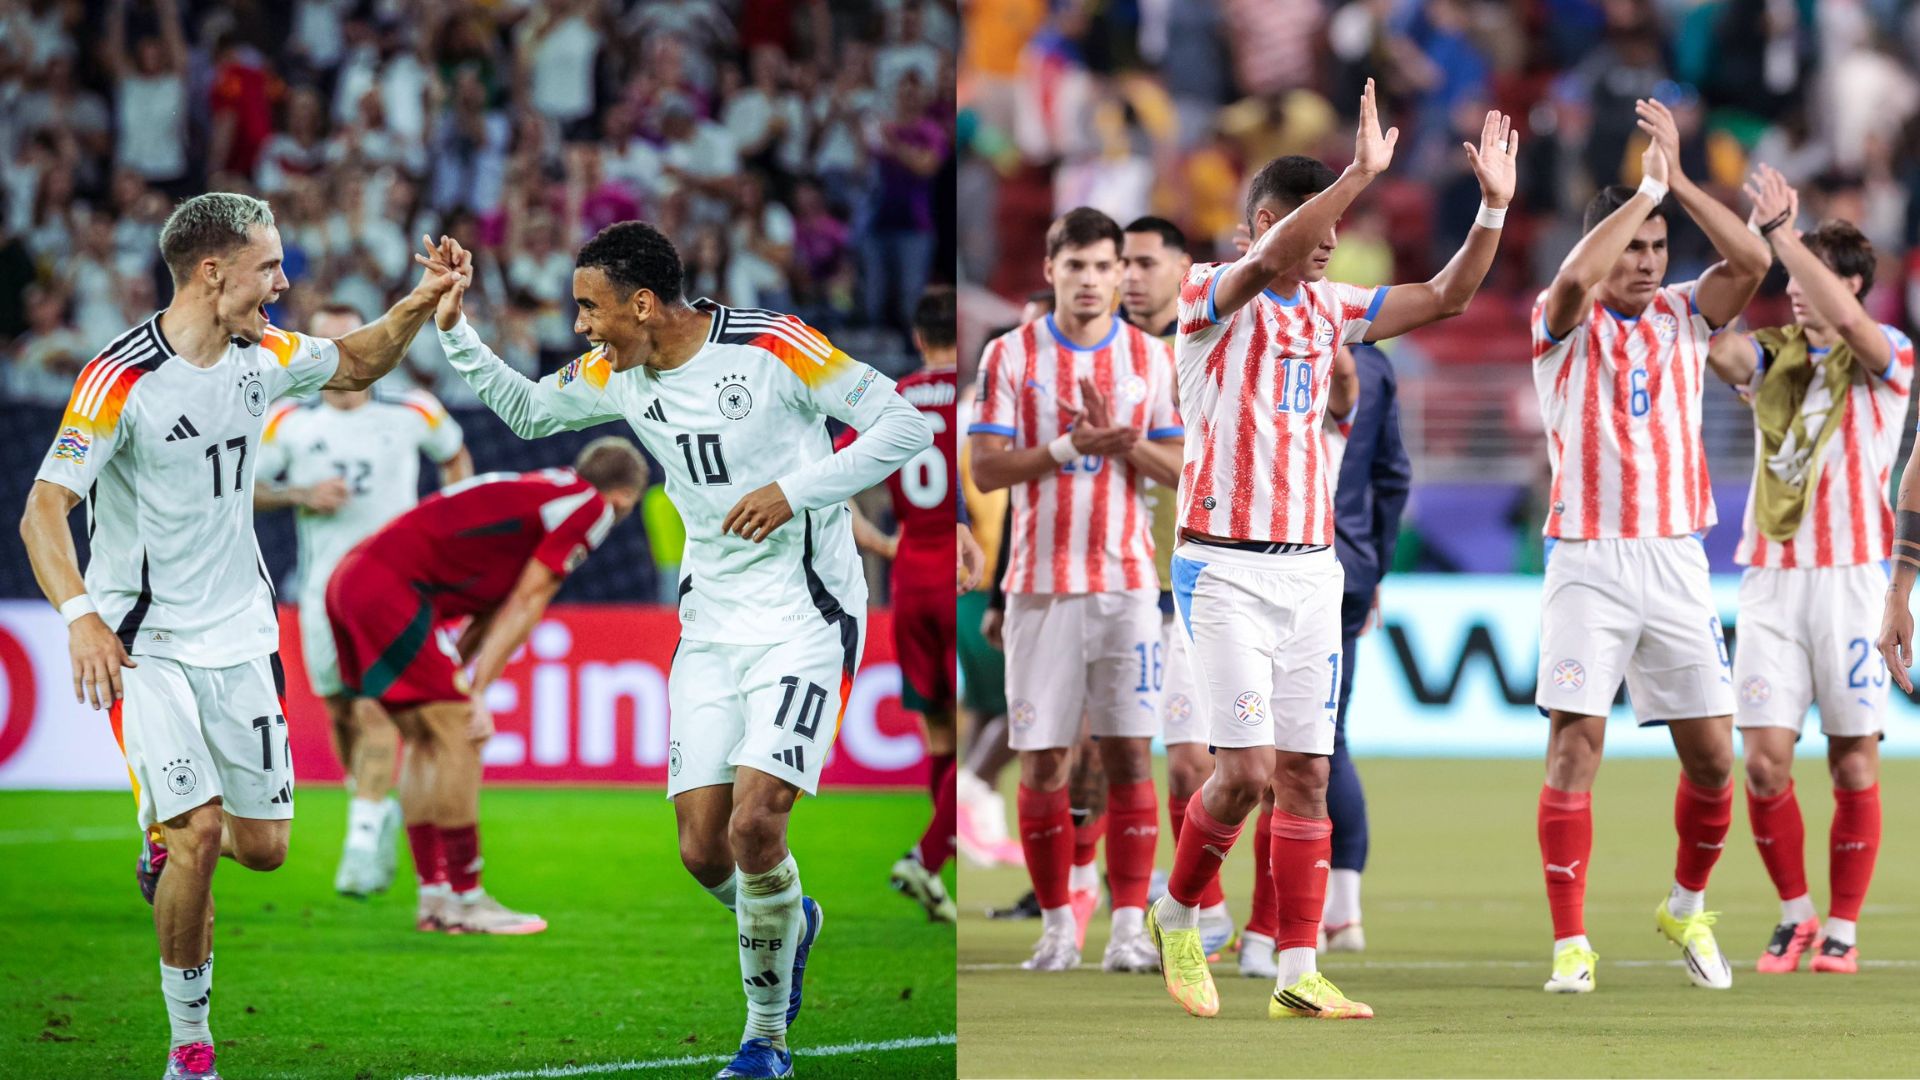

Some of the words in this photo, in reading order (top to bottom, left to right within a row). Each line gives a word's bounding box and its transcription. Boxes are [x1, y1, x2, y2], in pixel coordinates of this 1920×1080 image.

[1277, 359, 1312, 414] 18
[1631, 368, 1650, 417] 6
[205, 435, 247, 499] 17
[675, 433, 732, 486] 10
[774, 675, 828, 744] 10
[740, 932, 783, 951] DFB
